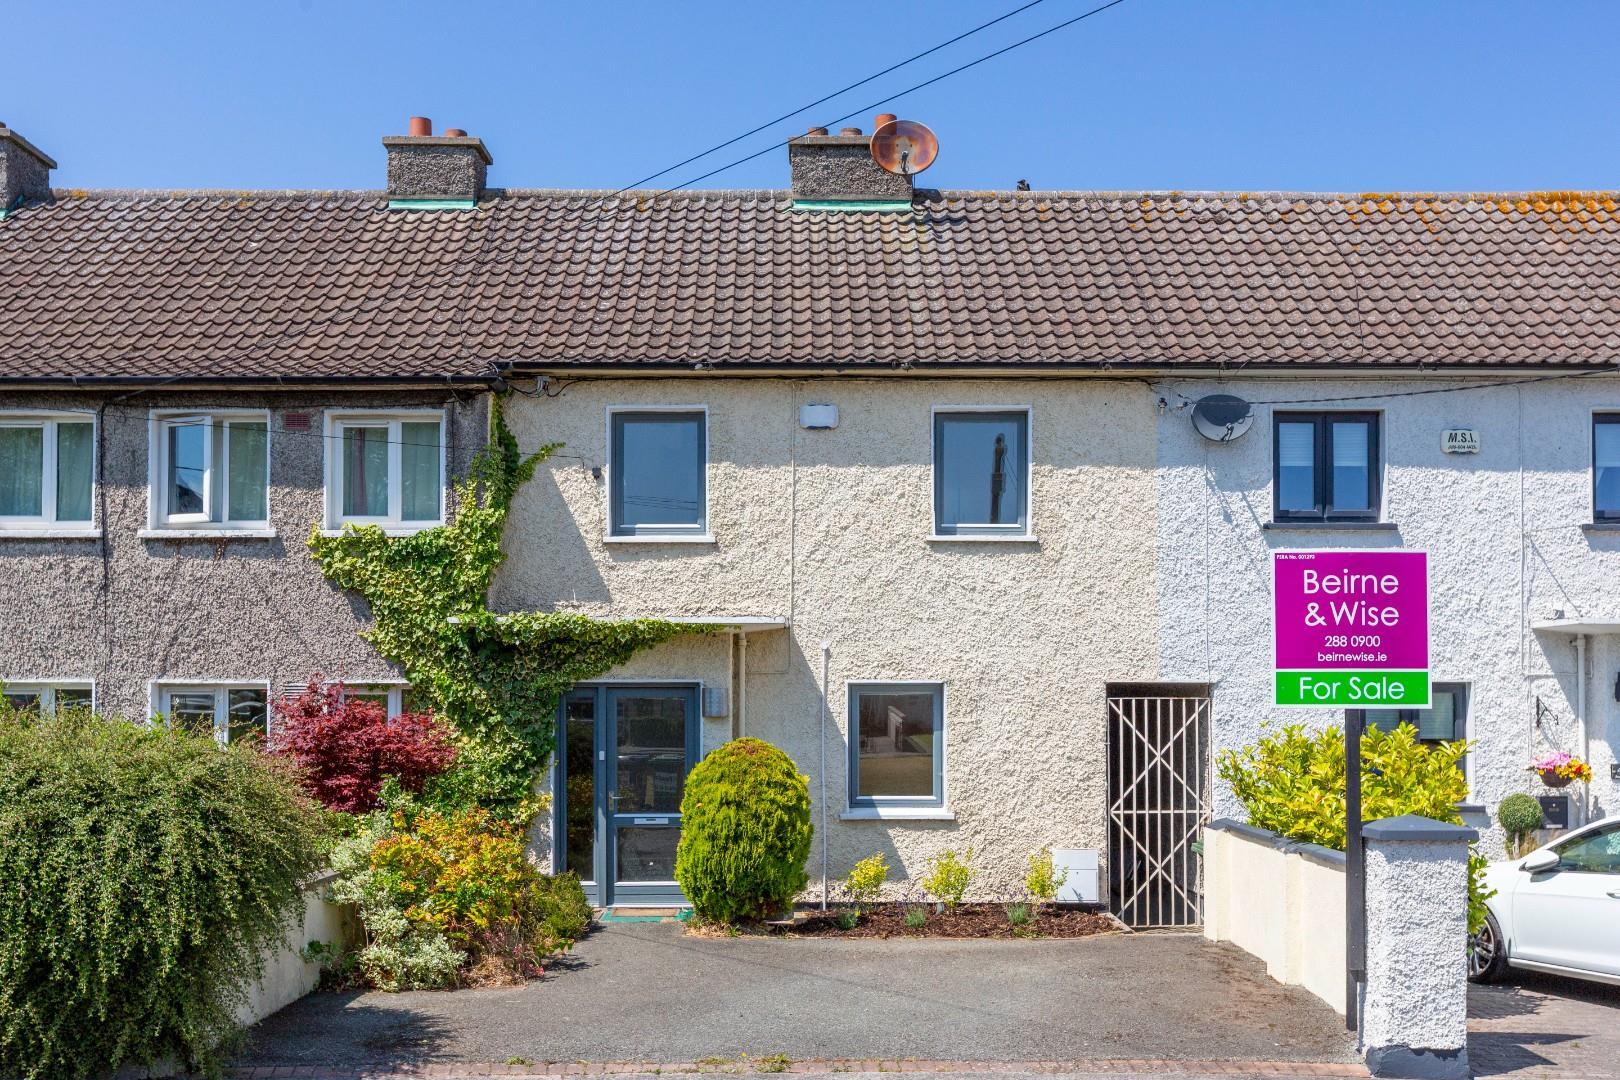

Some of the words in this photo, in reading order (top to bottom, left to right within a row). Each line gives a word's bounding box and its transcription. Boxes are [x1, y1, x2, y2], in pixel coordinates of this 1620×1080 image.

[1448, 432, 1477, 443] M.S.I.
[1303, 568, 1399, 594] Beirne
[1304, 602, 1328, 627] &
[1329, 600, 1400, 627] Wise
[1324, 635, 1348, 647] 288
[1350, 635, 1381, 647] 0900
[1317, 651, 1388, 662] beirnewise.ie
[1299, 676, 1341, 700] For
[1348, 676, 1405, 700] Sale
